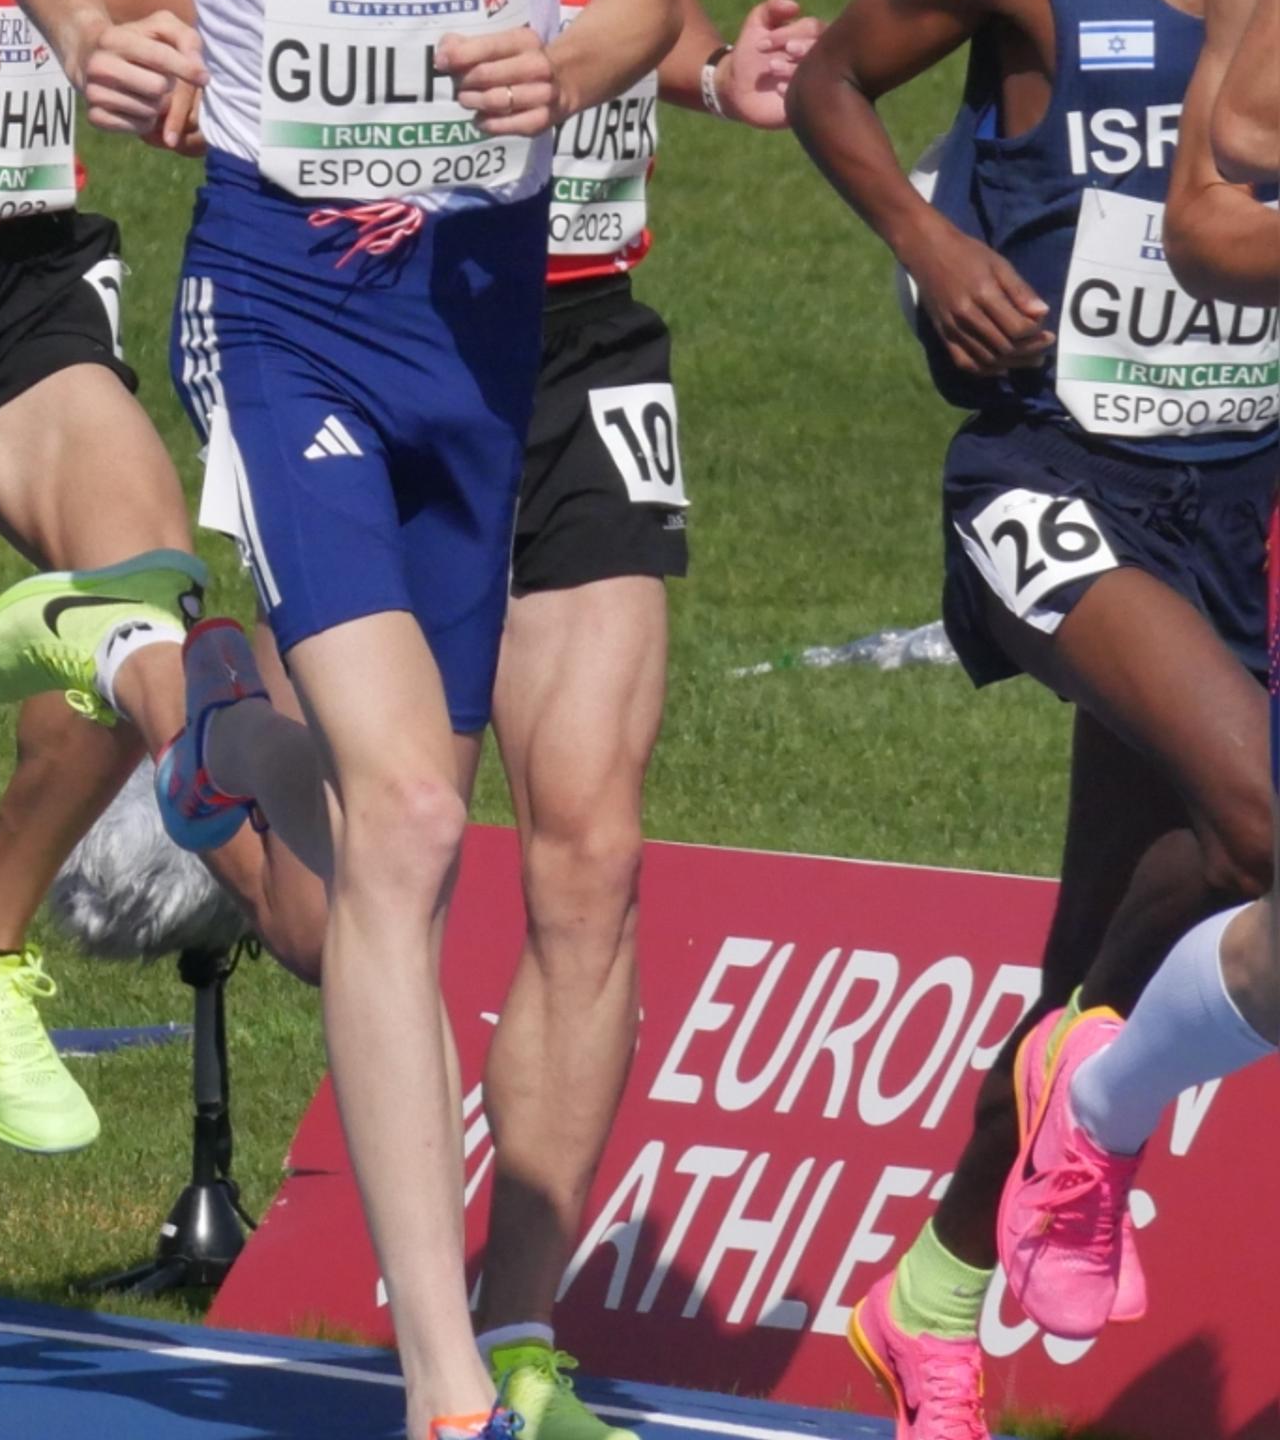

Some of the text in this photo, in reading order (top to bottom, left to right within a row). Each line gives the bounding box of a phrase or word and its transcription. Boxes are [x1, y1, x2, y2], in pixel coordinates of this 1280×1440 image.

[333, 0, 474, 15] SWITZERLAND
[335, 126, 392, 146] RUN
[397, 124, 482, 146] CLEAN
[298, 145, 507, 188] ESPOO 2023
[573, 211, 623, 242] 2023
[1069, 278, 1279, 348] GUAD
[1130, 363, 1187, 387] RUN
[1191, 363, 1269, 387] CLEAN
[1094, 394, 1210, 426] ESPOO
[603, 401, 676, 487] 10
[991, 499, 1102, 596] 26
